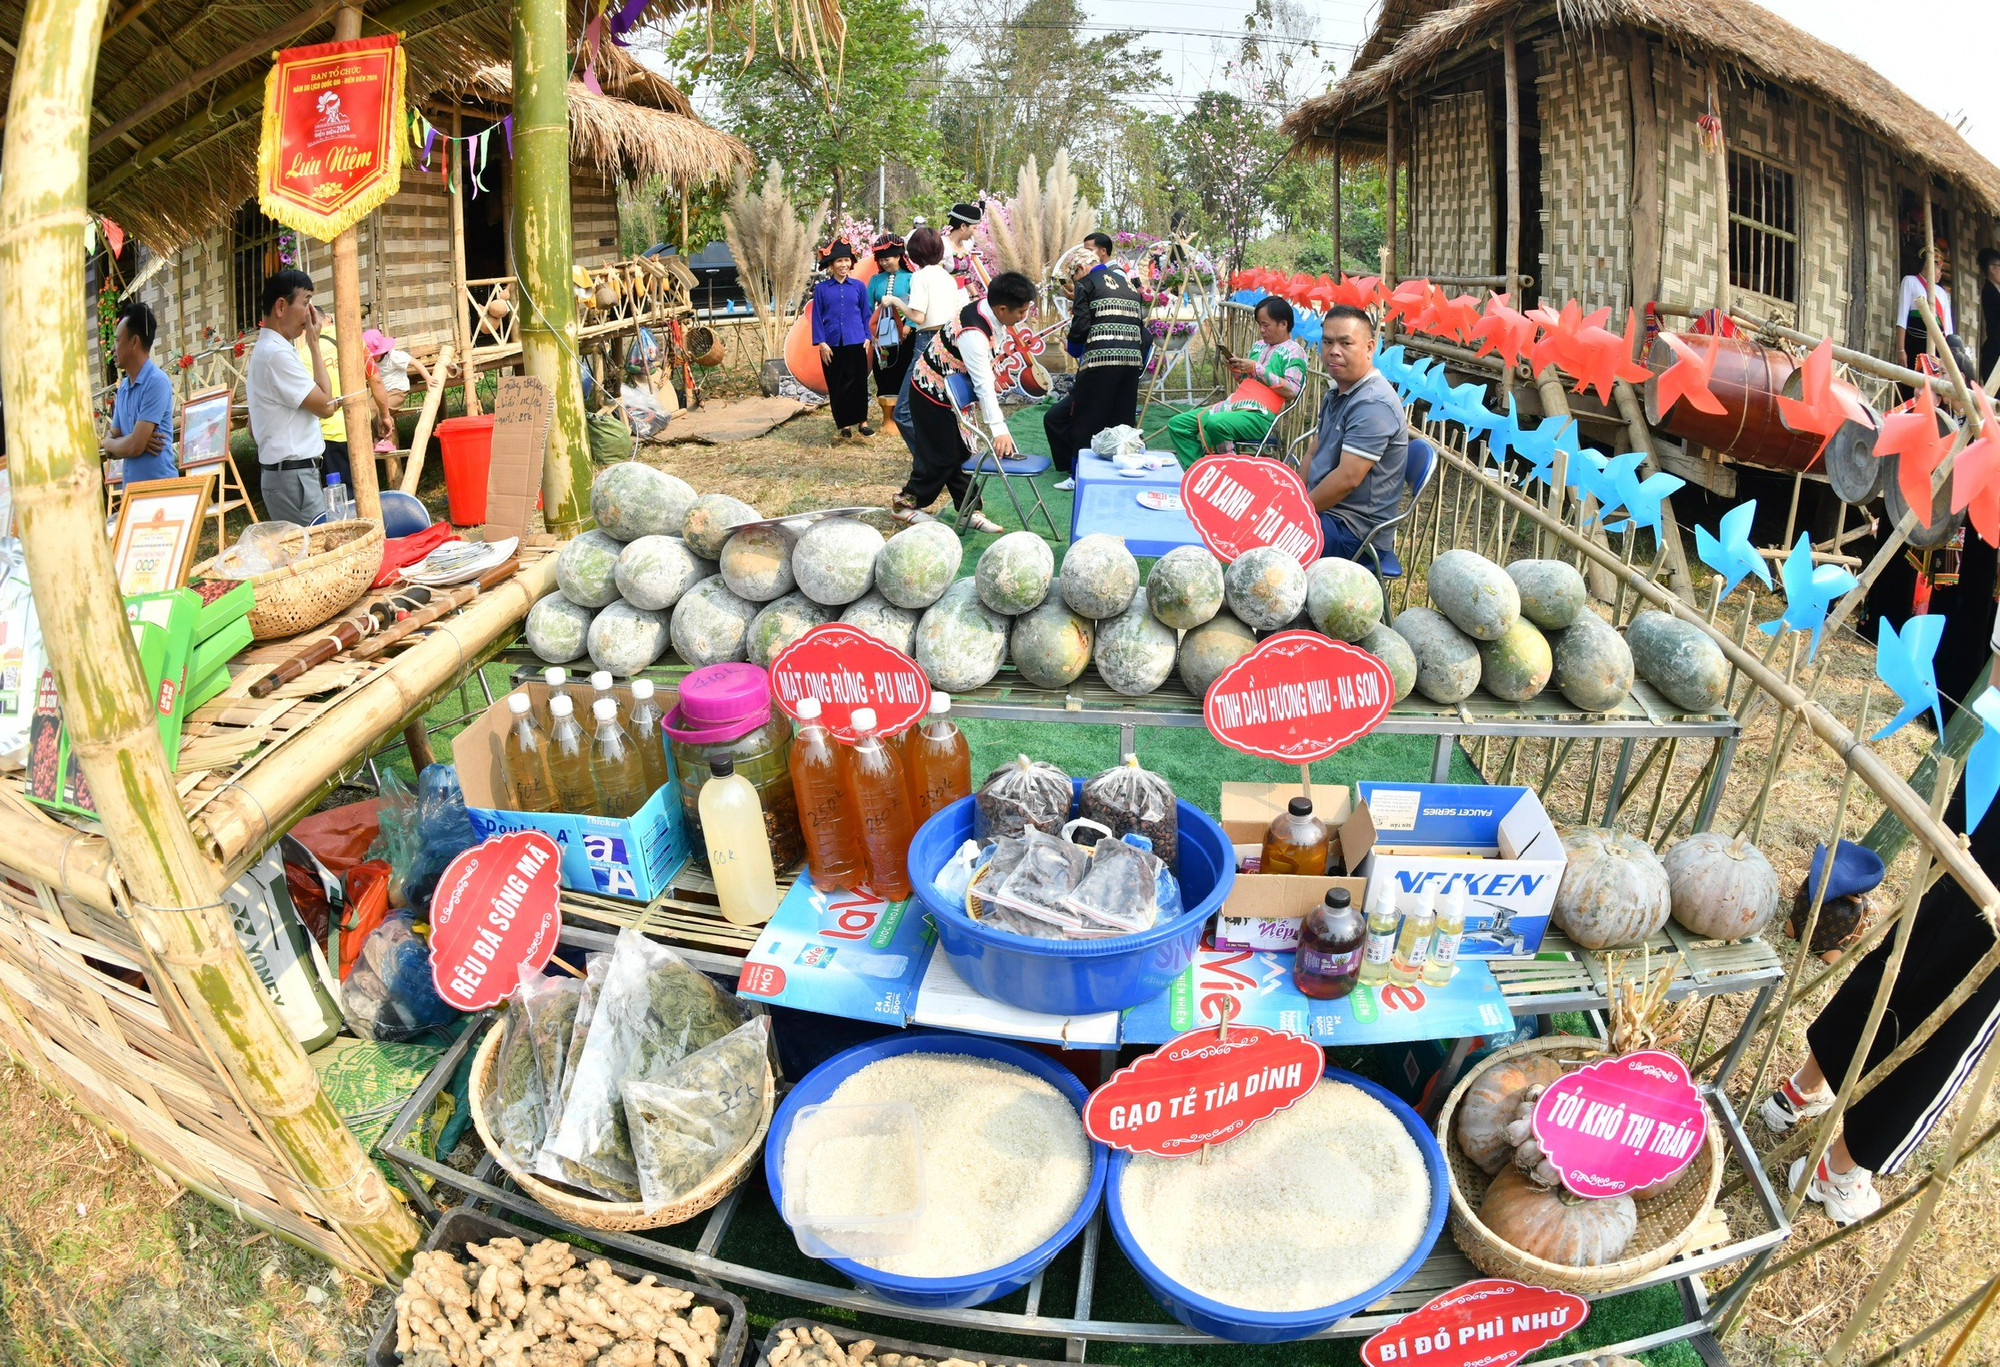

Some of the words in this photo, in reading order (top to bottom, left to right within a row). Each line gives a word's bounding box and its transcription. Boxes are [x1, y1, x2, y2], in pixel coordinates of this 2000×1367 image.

[311, 72, 327, 81] BAN
[329, 66, 340, 77] TỔ
[340, 66, 361, 76] CHỨC
[285, 152, 321, 180] Lưu
[326, 145, 372, 178] Niệm
[1192, 465, 1227, 498] BÍ
[1207, 475, 1255, 522] XANH
[1253, 505, 1285, 544] TÌA
[1272, 521, 1315, 562] DÌNH
[804, 672, 832, 704] ONG
[830, 663, 866, 704] RỪNG
[877, 672, 895, 703] PU
[896, 672, 919, 704] NHI
[1215, 692, 1243, 729] TINH
[1242, 675, 1267, 726] DẦU
[1267, 681, 1307, 722] HƯƠNG
[1306, 678, 1332, 715] NHU
[1337, 676, 1356, 711] NA
[1356, 671, 1380, 708] SON
[586, 816, 621, 828] Thicker
[1423, 808, 1457, 816] SERIES
[1457, 809, 1493, 817] FAUCET
[557, 829, 569, 844] A
[450, 955, 488, 1000] RÊU
[472, 925, 503, 961] ĐÁ
[488, 874, 529, 931] SÔNG
[515, 842, 551, 880] MÃ
[1258, 920, 1294, 940] Nếp
[804, 946, 826, 966] laVie
[759, 968, 775, 992] MỚI
[874, 1001, 883, 1012] 24
[883, 991, 893, 1013] CHAI
[1176, 996, 1186, 1024] NHIÊN
[1326, 1016, 1334, 1035] CHAI
[1334, 1015, 1342, 1025] 24
[1109, 1101, 1161, 1132] GẠO
[1169, 1086, 1197, 1118] TẺ
[1204, 1082, 1239, 1111] TÌA
[1244, 1062, 1302, 1098] DÌNH
[1547, 1086, 1586, 1129] TỎI
[1578, 1101, 1627, 1141] KHÔ
[1620, 1113, 1656, 1156] THỊ
[1648, 1117, 1696, 1159] TRẤN
[1379, 1337, 1408, 1362] BÍ
[1414, 1326, 1451, 1355] ĐỎ
[1458, 1316, 1504, 1345] PHÌ
[1512, 1306, 1570, 1333] NHỪ
